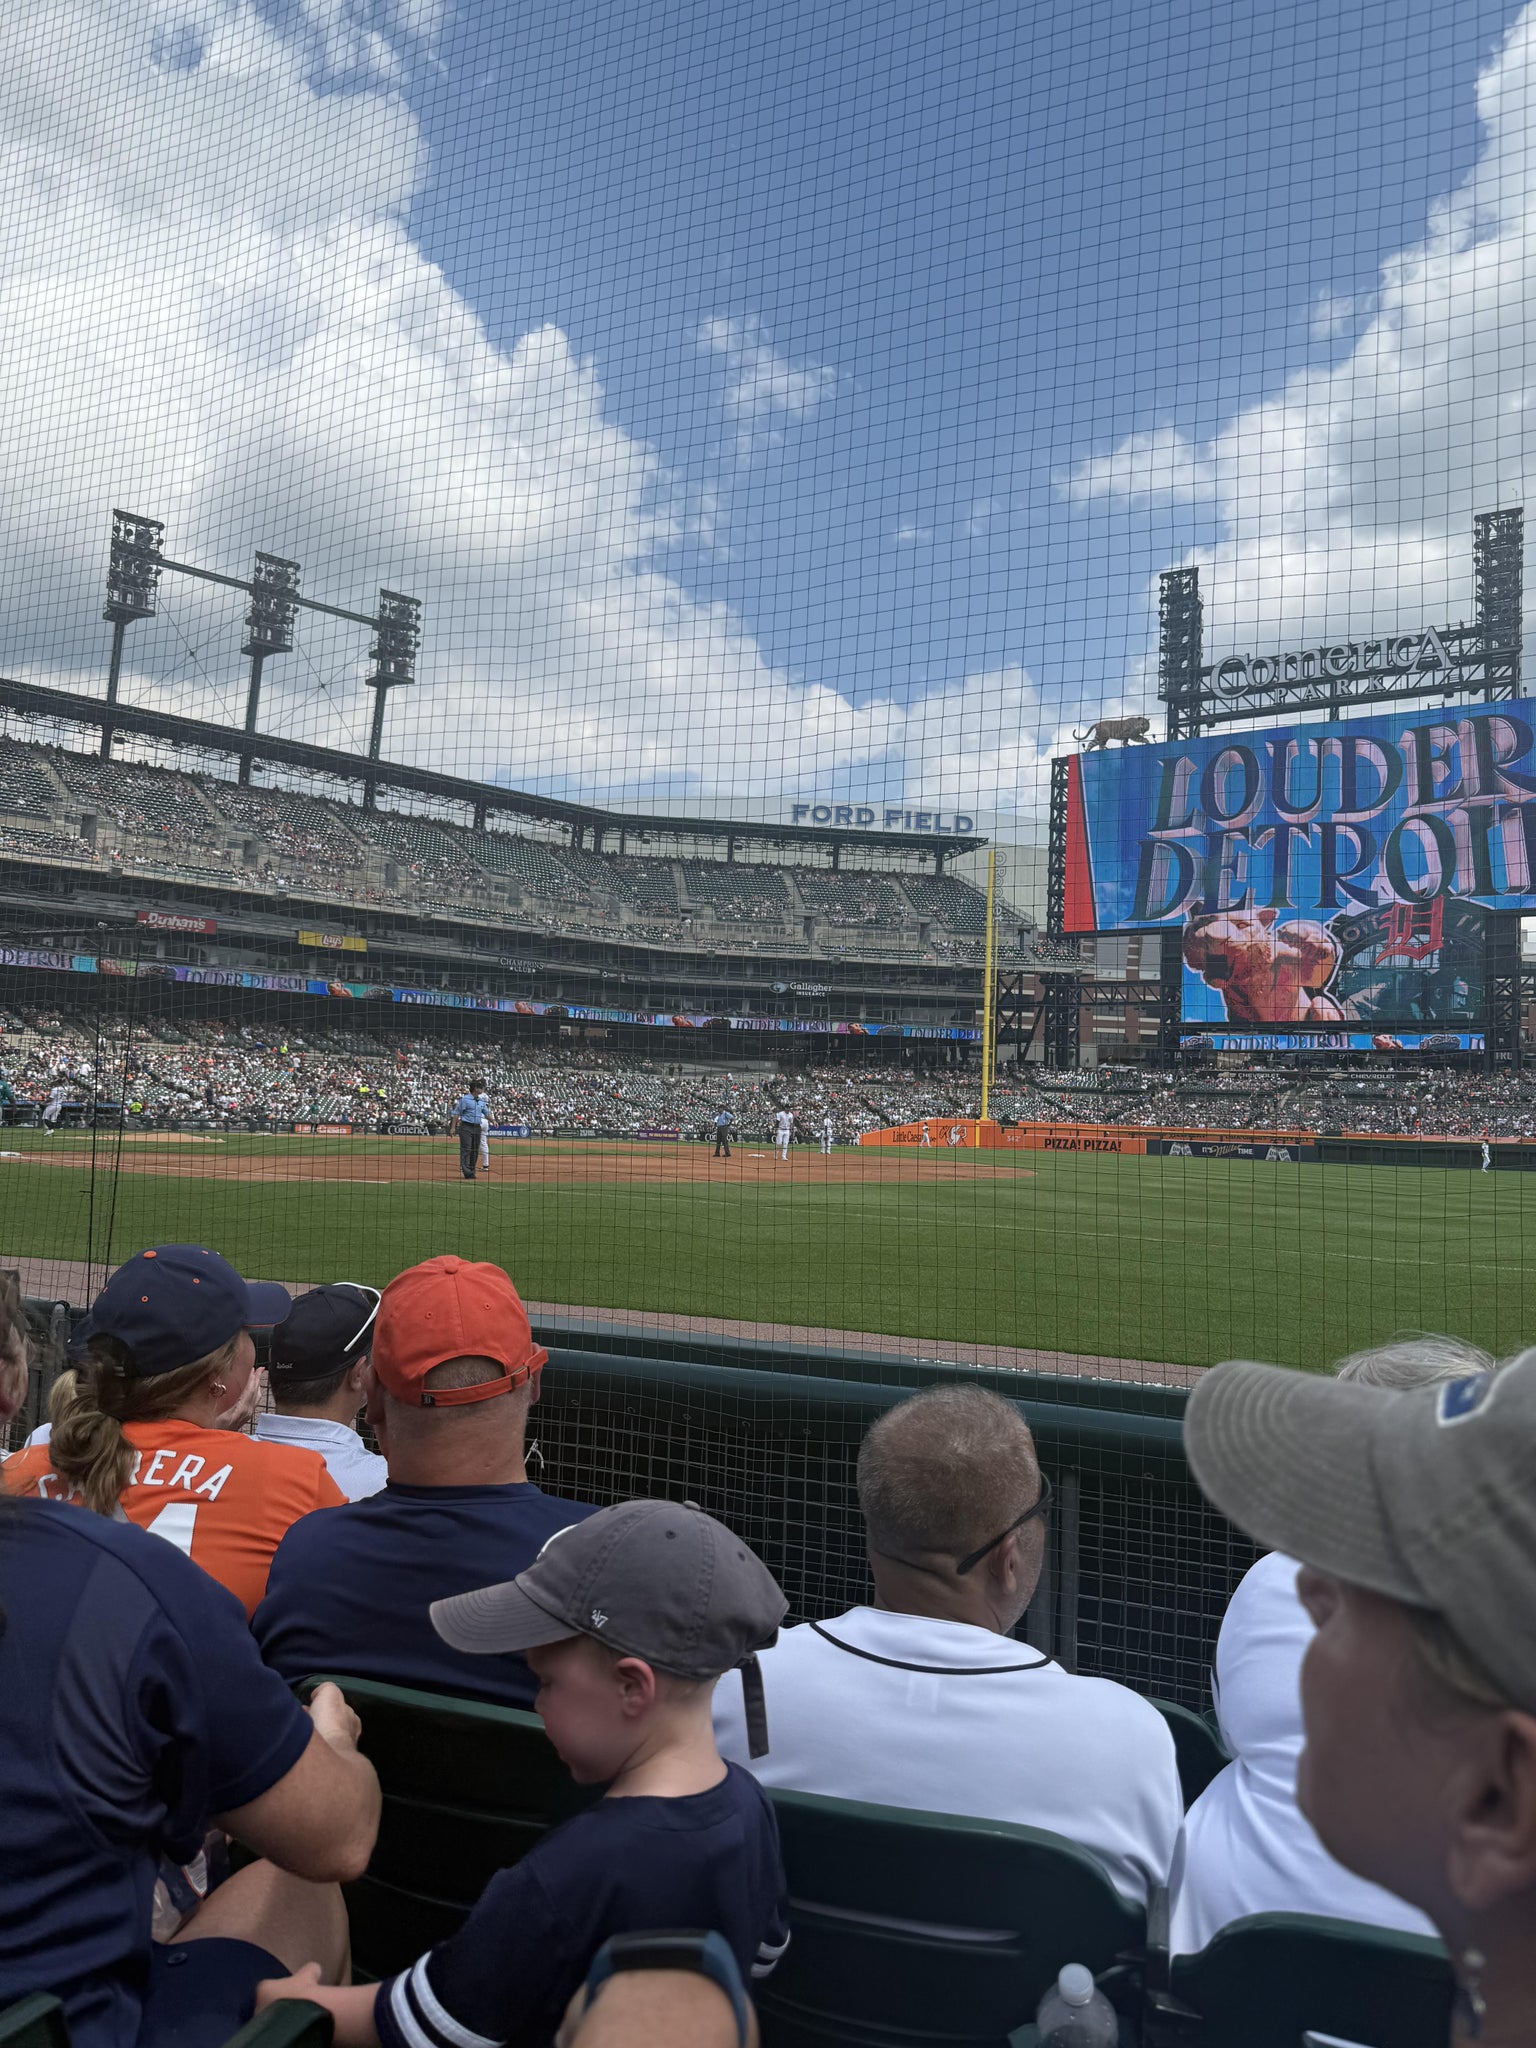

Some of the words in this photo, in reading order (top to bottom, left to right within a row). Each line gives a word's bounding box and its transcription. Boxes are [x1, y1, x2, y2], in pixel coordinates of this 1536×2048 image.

[1275, 676, 1386, 704] PARK
[1147, 714, 1536, 838] LOUDER
[792, 804, 875, 825] FORD
[885, 809, 974, 833] FIELD
[148, 912, 206, 930] Dunham's
[322, 935, 343, 948] Lay's
[500, 957, 544, 970] CHAMPIONS
[789, 981, 833, 993] Gallagher
[1044, 1138, 1081, 1150] PIZZA!
[1083, 1139, 1122, 1152] PIZZA!
